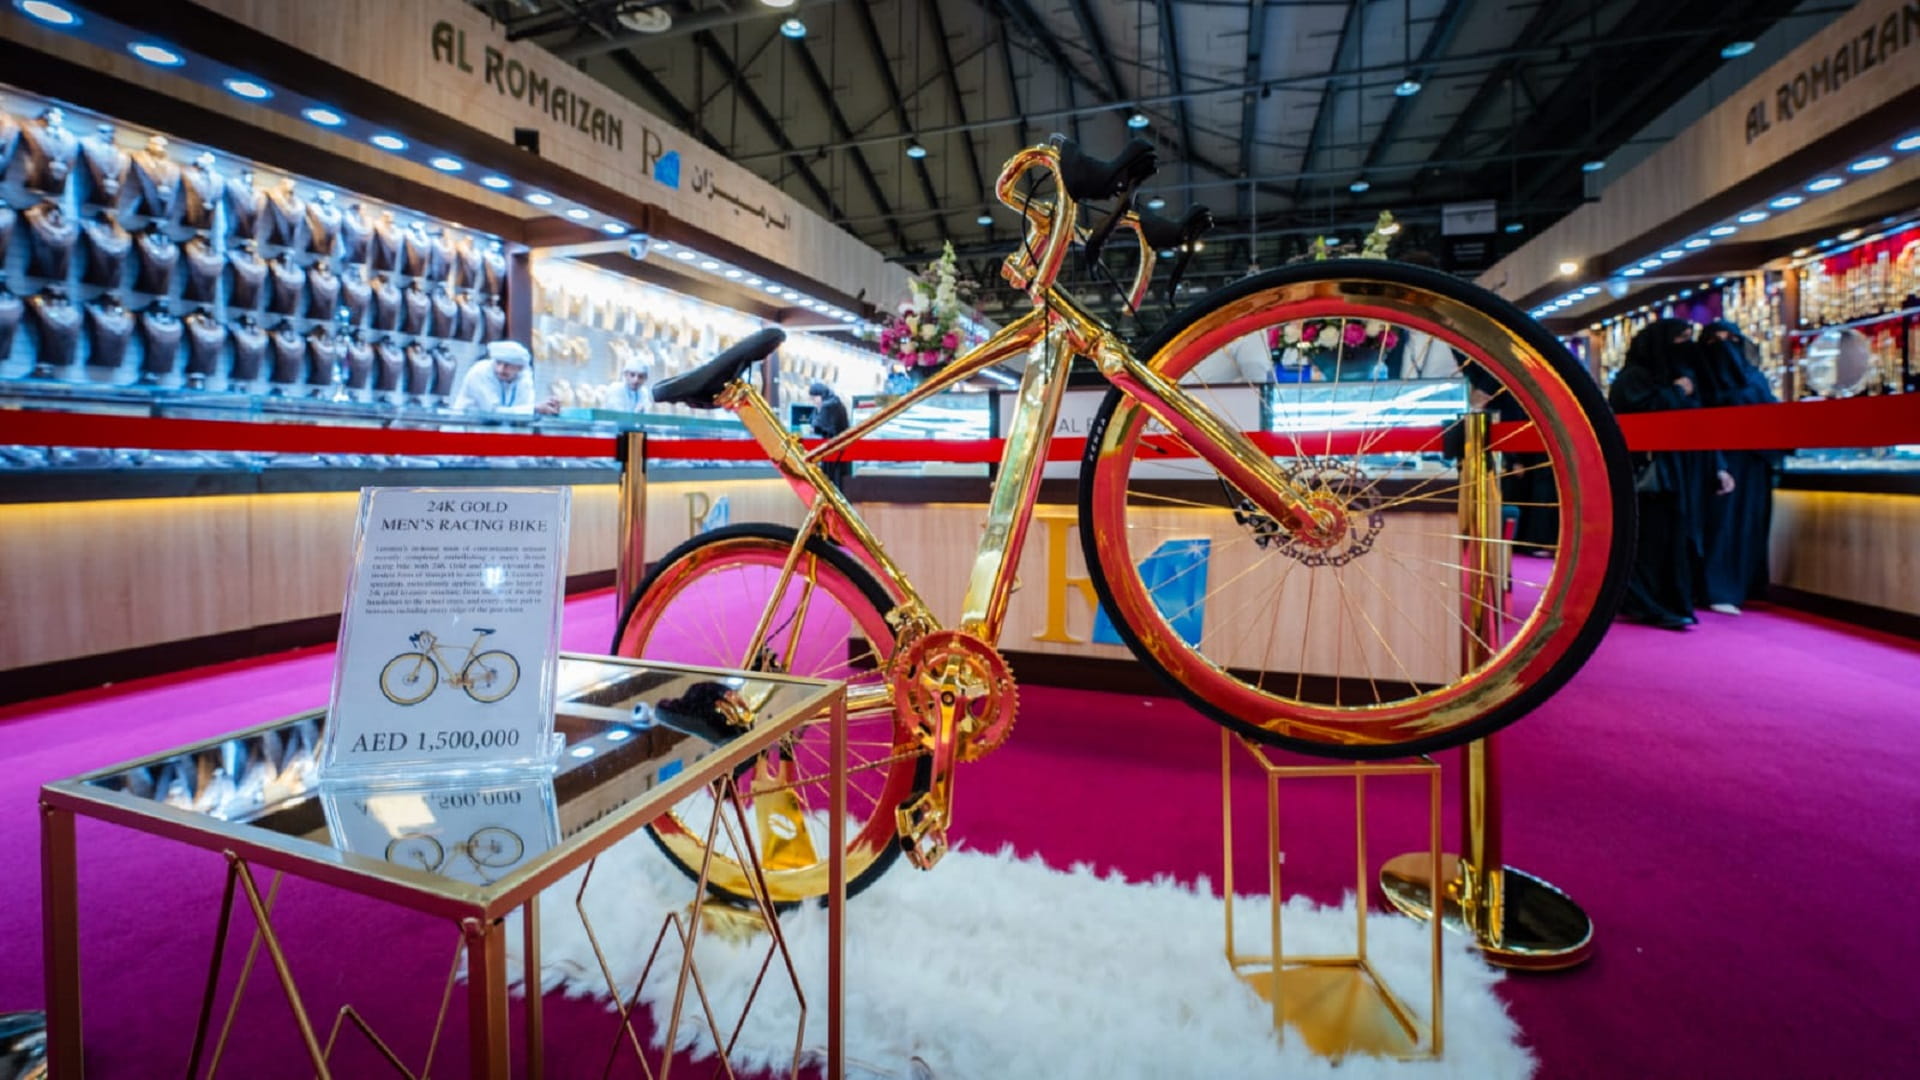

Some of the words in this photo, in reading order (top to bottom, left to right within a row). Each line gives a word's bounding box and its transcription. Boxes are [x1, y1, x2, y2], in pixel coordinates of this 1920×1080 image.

[432, 20, 473, 73] AL
[485, 45, 623, 151] ROMAIZAN
[1745, 99, 1771, 145] AL
[1057, 417, 1080, 433] AL
[426, 500, 455, 513] 24K
[460, 500, 508, 513] GOLD
[380, 518, 434, 532] MEN'S
[439, 518, 503, 532] RACING
[509, 519, 548, 532] BIKE
[351, 732, 407, 752] AED
[419, 729, 520, 753] 1,500,000
